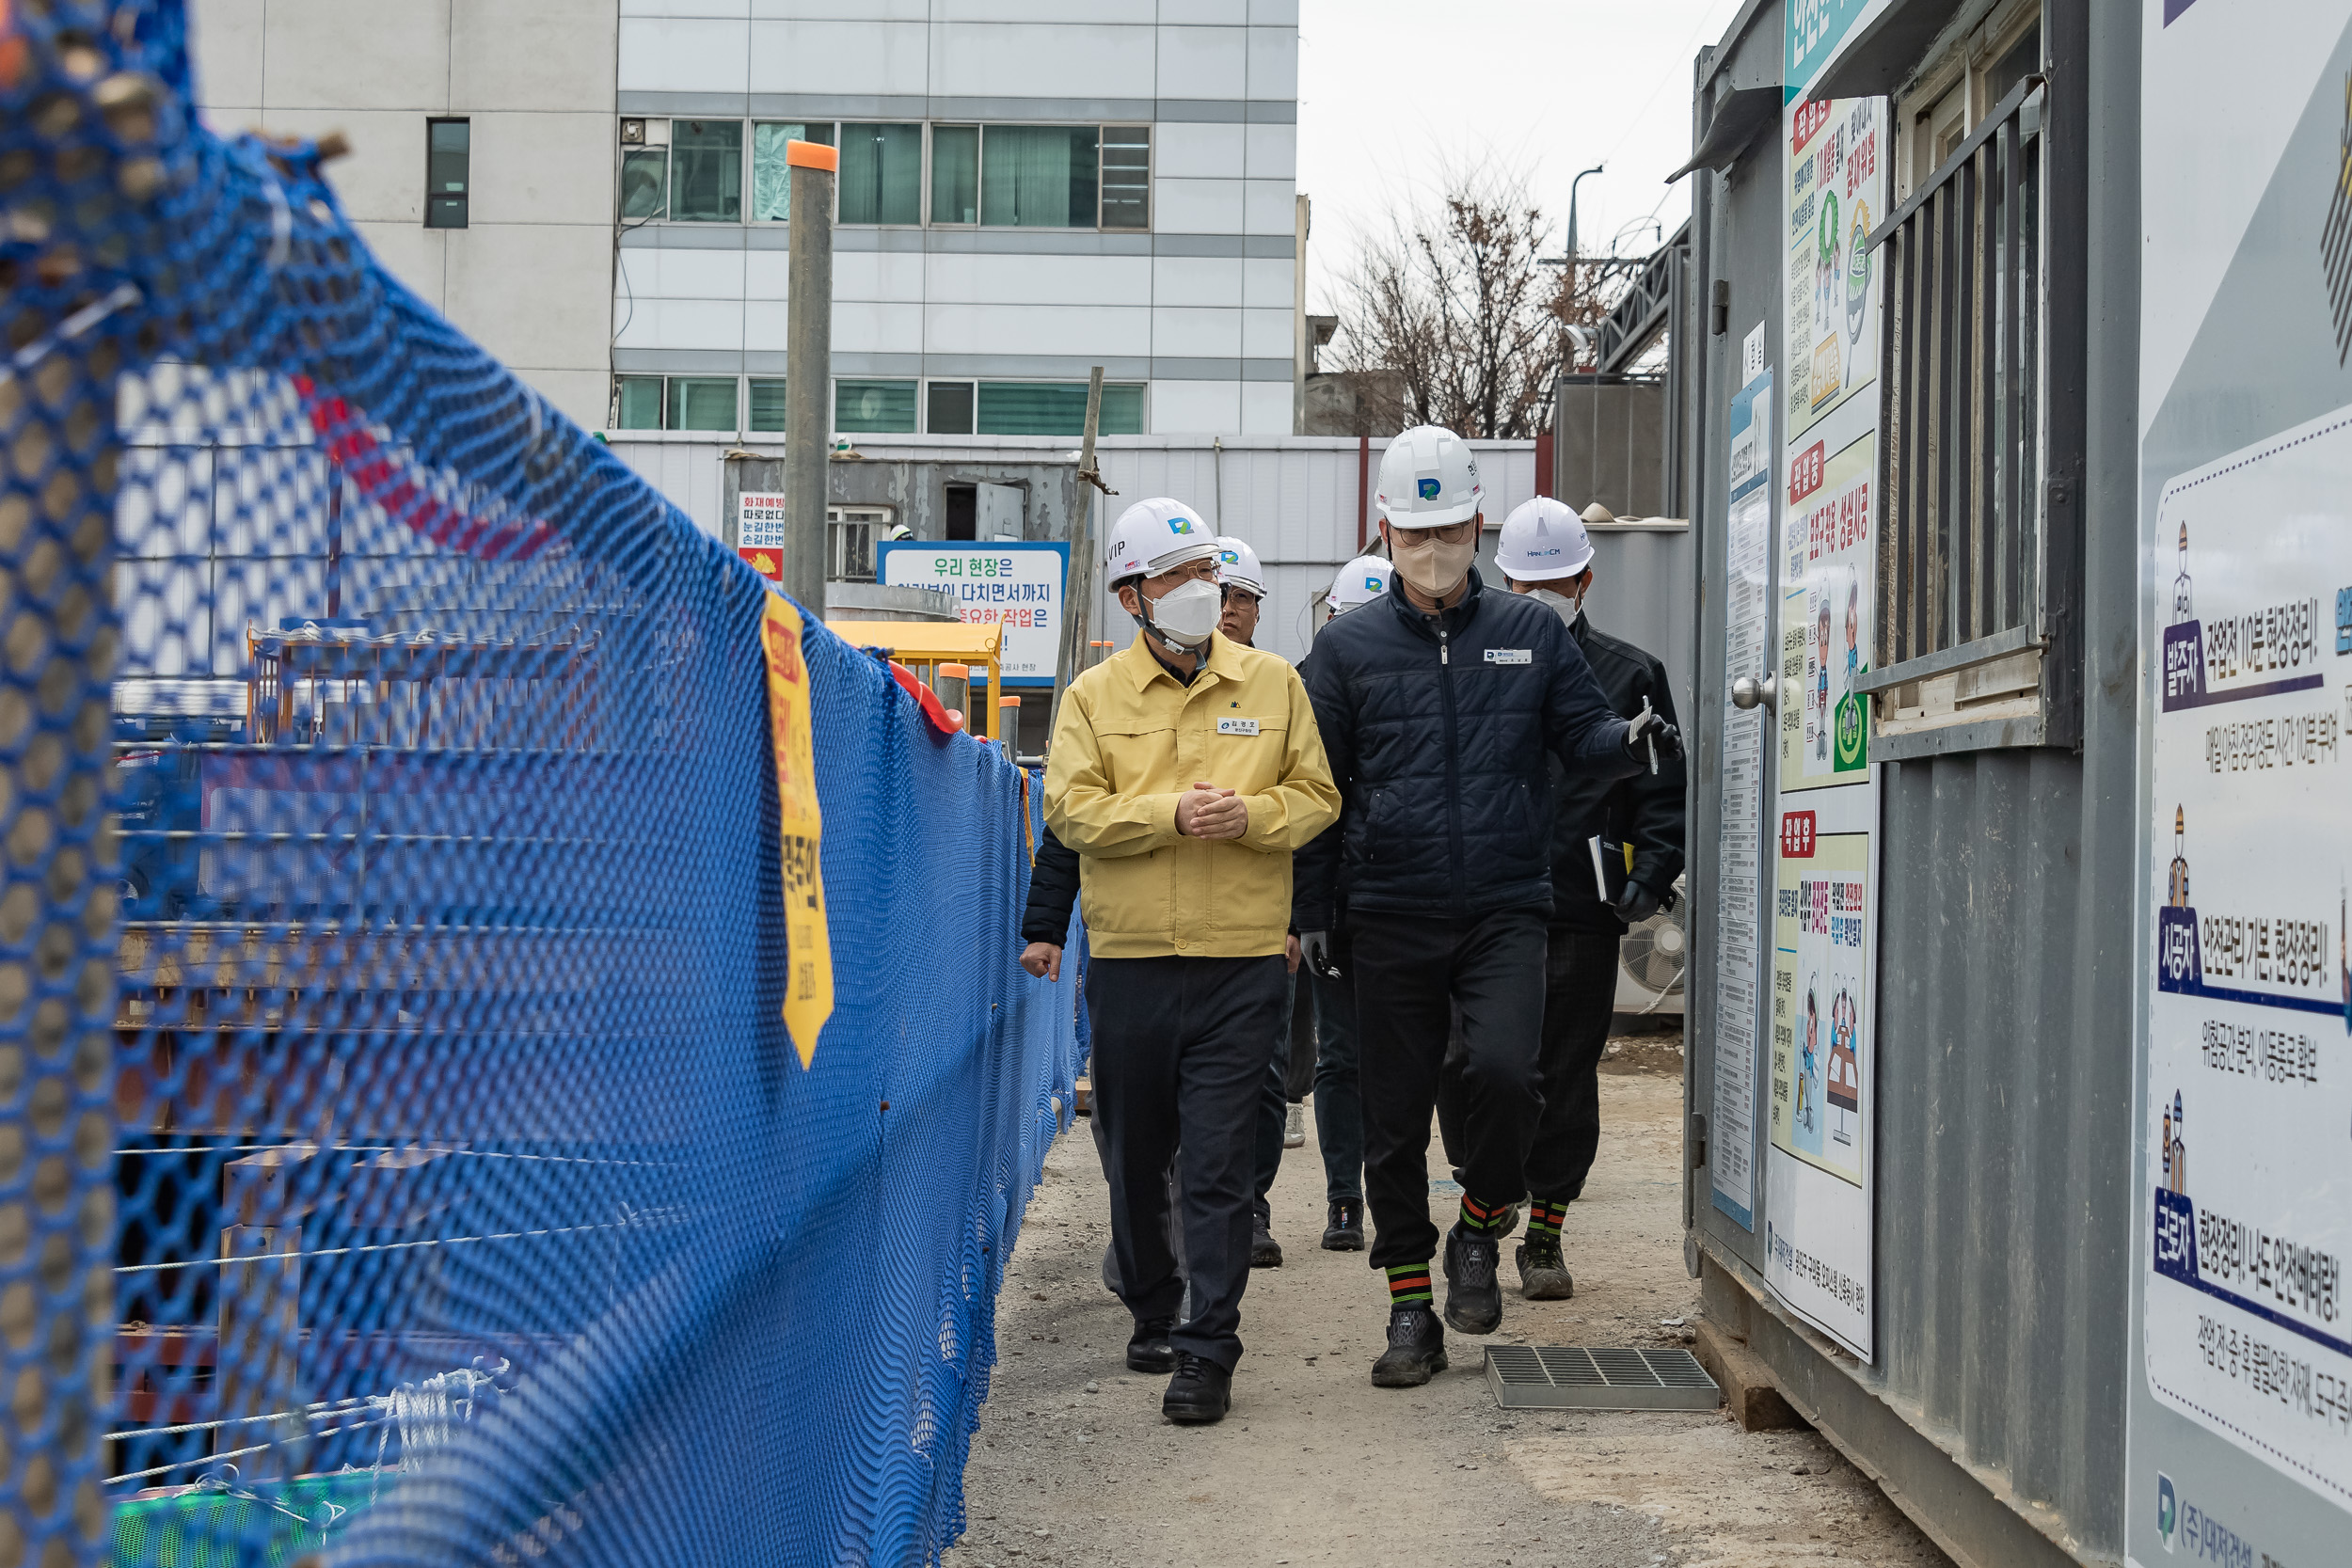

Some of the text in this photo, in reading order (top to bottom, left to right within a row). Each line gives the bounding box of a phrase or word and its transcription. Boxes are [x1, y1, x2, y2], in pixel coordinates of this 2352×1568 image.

[1846, 128, 1875, 200] 잠재위험
[1794, 450, 1820, 497] 작업중
[743, 509, 785, 520] 따로없다
[744, 497, 785, 509] 화재예방
[742, 534, 784, 546] 손길한번
[743, 522, 784, 533] 눈길한번
[934, 558, 1013, 578] 우리 현장은
[1108, 540, 1125, 562] VIP
[961, 583, 1051, 602] 다치면서까지
[1003, 608, 1048, 628] 작업은
[2167, 636, 2199, 697] 발주자
[2207, 616, 2237, 682] 작업전
[2240, 610, 2265, 673] 10분
[2266, 596, 2318, 671] 현장정리!
[2205, 724, 2221, 773] 매일
[2222, 722, 2238, 773] 아침
[2239, 719, 2275, 771] 정리정돈
[2275, 714, 2295, 768] 시간
[2296, 712, 2317, 765] 10분
[2317, 708, 2338, 764] 부여
[1786, 817, 1810, 852] 작업후
[1812, 880, 1829, 935] 정리정돈
[2162, 914, 2328, 990] 시공자 안전관리 기본, 현장정리!
[2201, 1020, 2236, 1072] 위험공간
[2258, 1028, 2296, 1084] 이동통로
[2296, 1034, 2318, 1088] 확보
[2157, 1204, 2190, 1271] 근로자
[2199, 1208, 2247, 1286] 현장정리!
[2249, 1227, 2272, 1292] 나도
[2198, 1314, 2216, 1367] 작업
[2252, 1337, 2290, 1404] 불필요한
[2314, 1370, 2337, 1430] 도구
